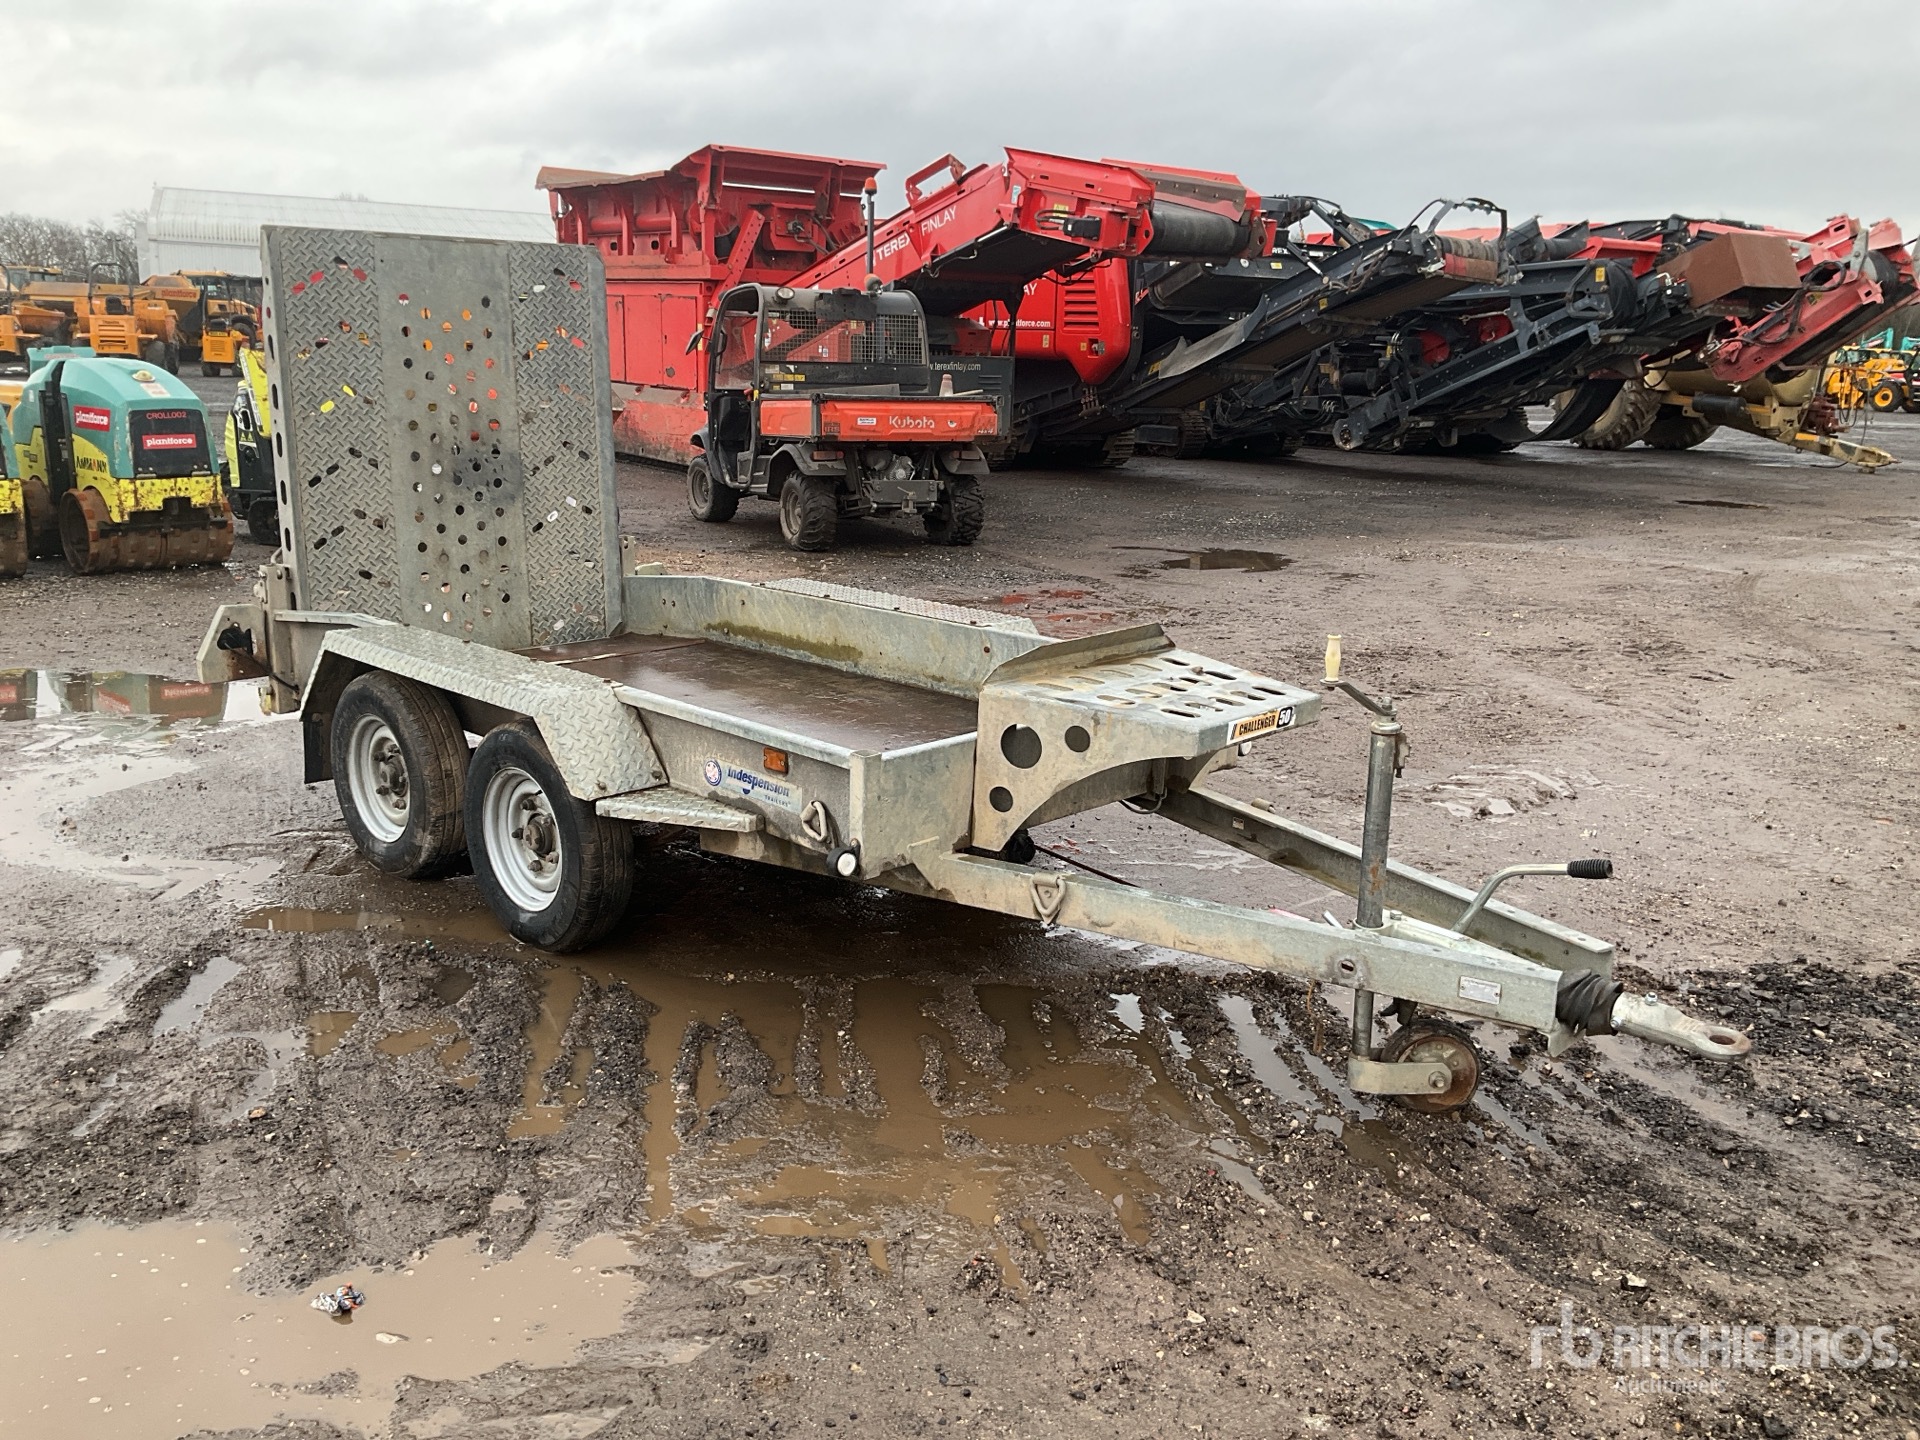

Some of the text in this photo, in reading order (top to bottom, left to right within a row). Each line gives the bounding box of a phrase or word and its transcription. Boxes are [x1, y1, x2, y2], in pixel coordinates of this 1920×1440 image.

[921, 206, 956, 236] FINLAY
[75, 410, 109, 426] plantforce
[889, 416, 935, 429] Kubota
[146, 436, 193, 447] plantforce
[1239, 709, 1291, 736] CHALLENGER 50
[727, 766, 790, 797] indespension
